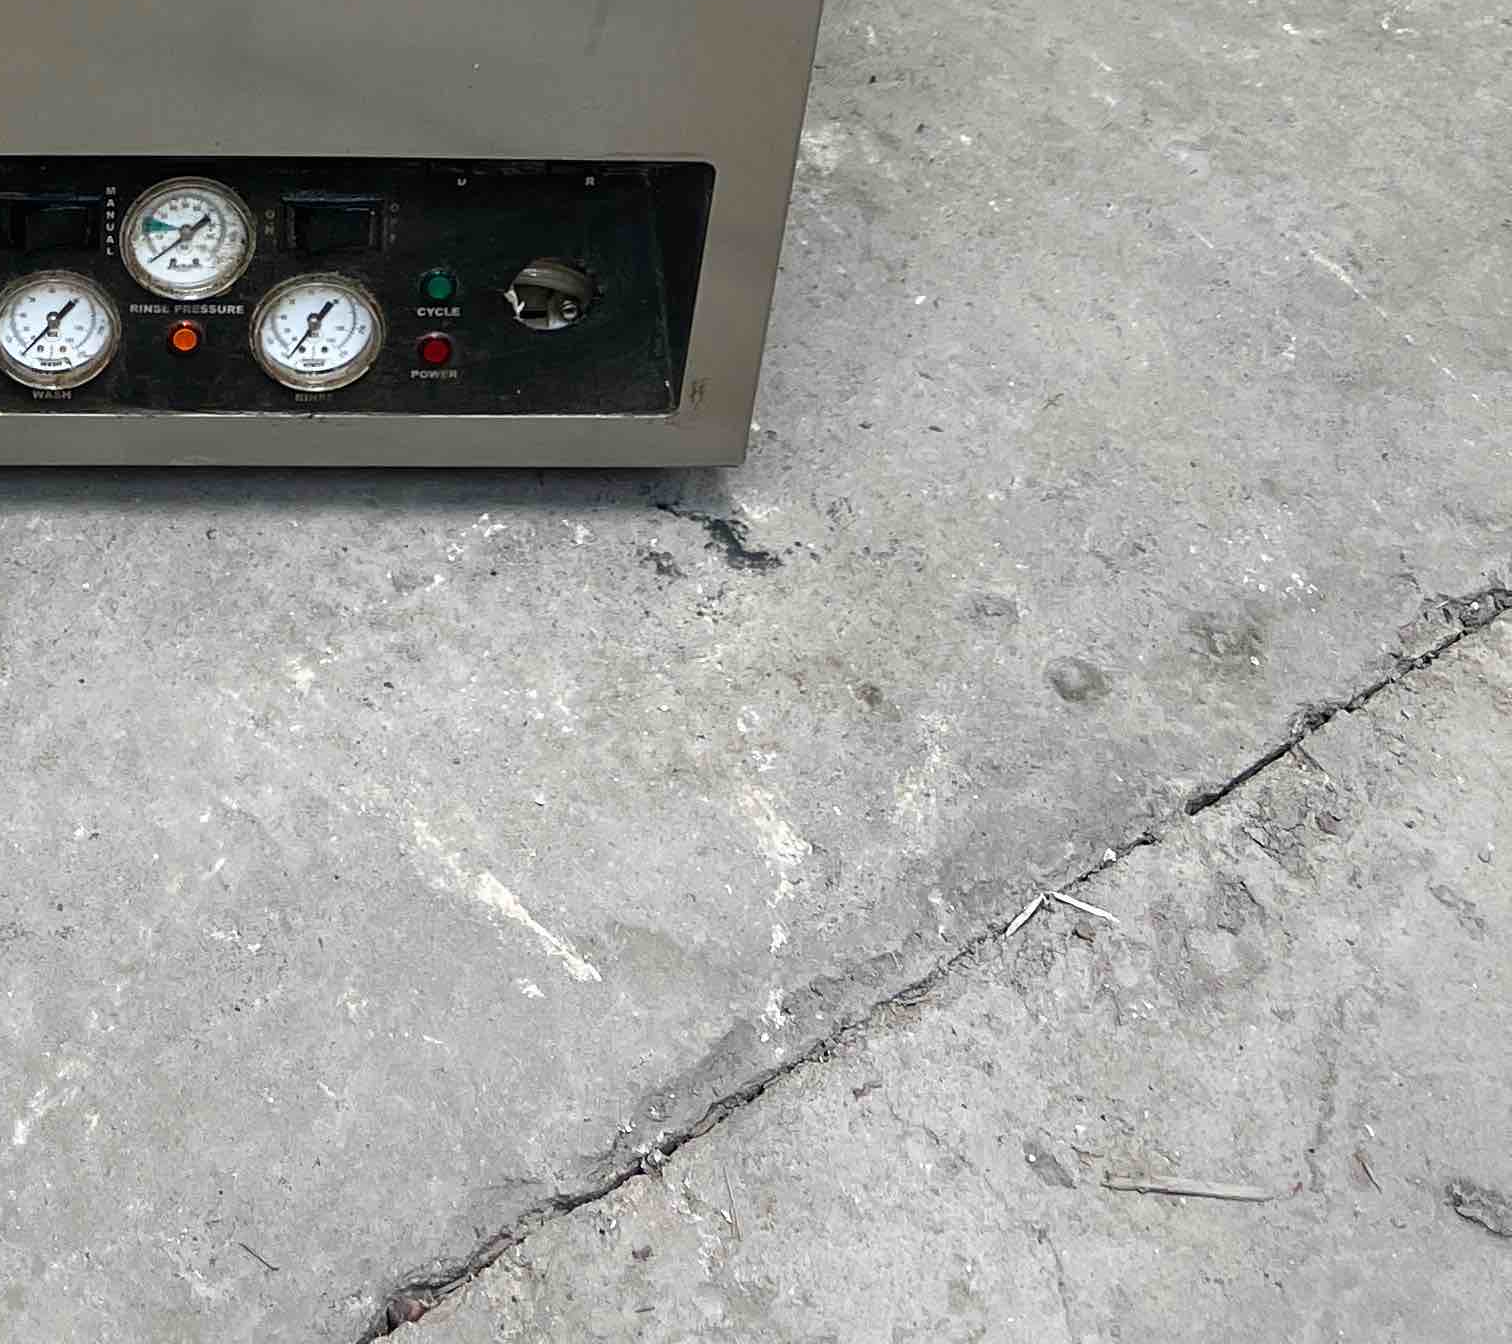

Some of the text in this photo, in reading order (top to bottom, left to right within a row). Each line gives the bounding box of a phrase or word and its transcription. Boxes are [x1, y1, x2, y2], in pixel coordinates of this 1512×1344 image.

[104, 185, 117, 256] MANUAL
[128, 303, 247, 315] RINSE PRESSURE
[416, 306, 462, 318] CYCLE
[409, 369, 459, 380] POWER
[32, 390, 73, 400] WASH
